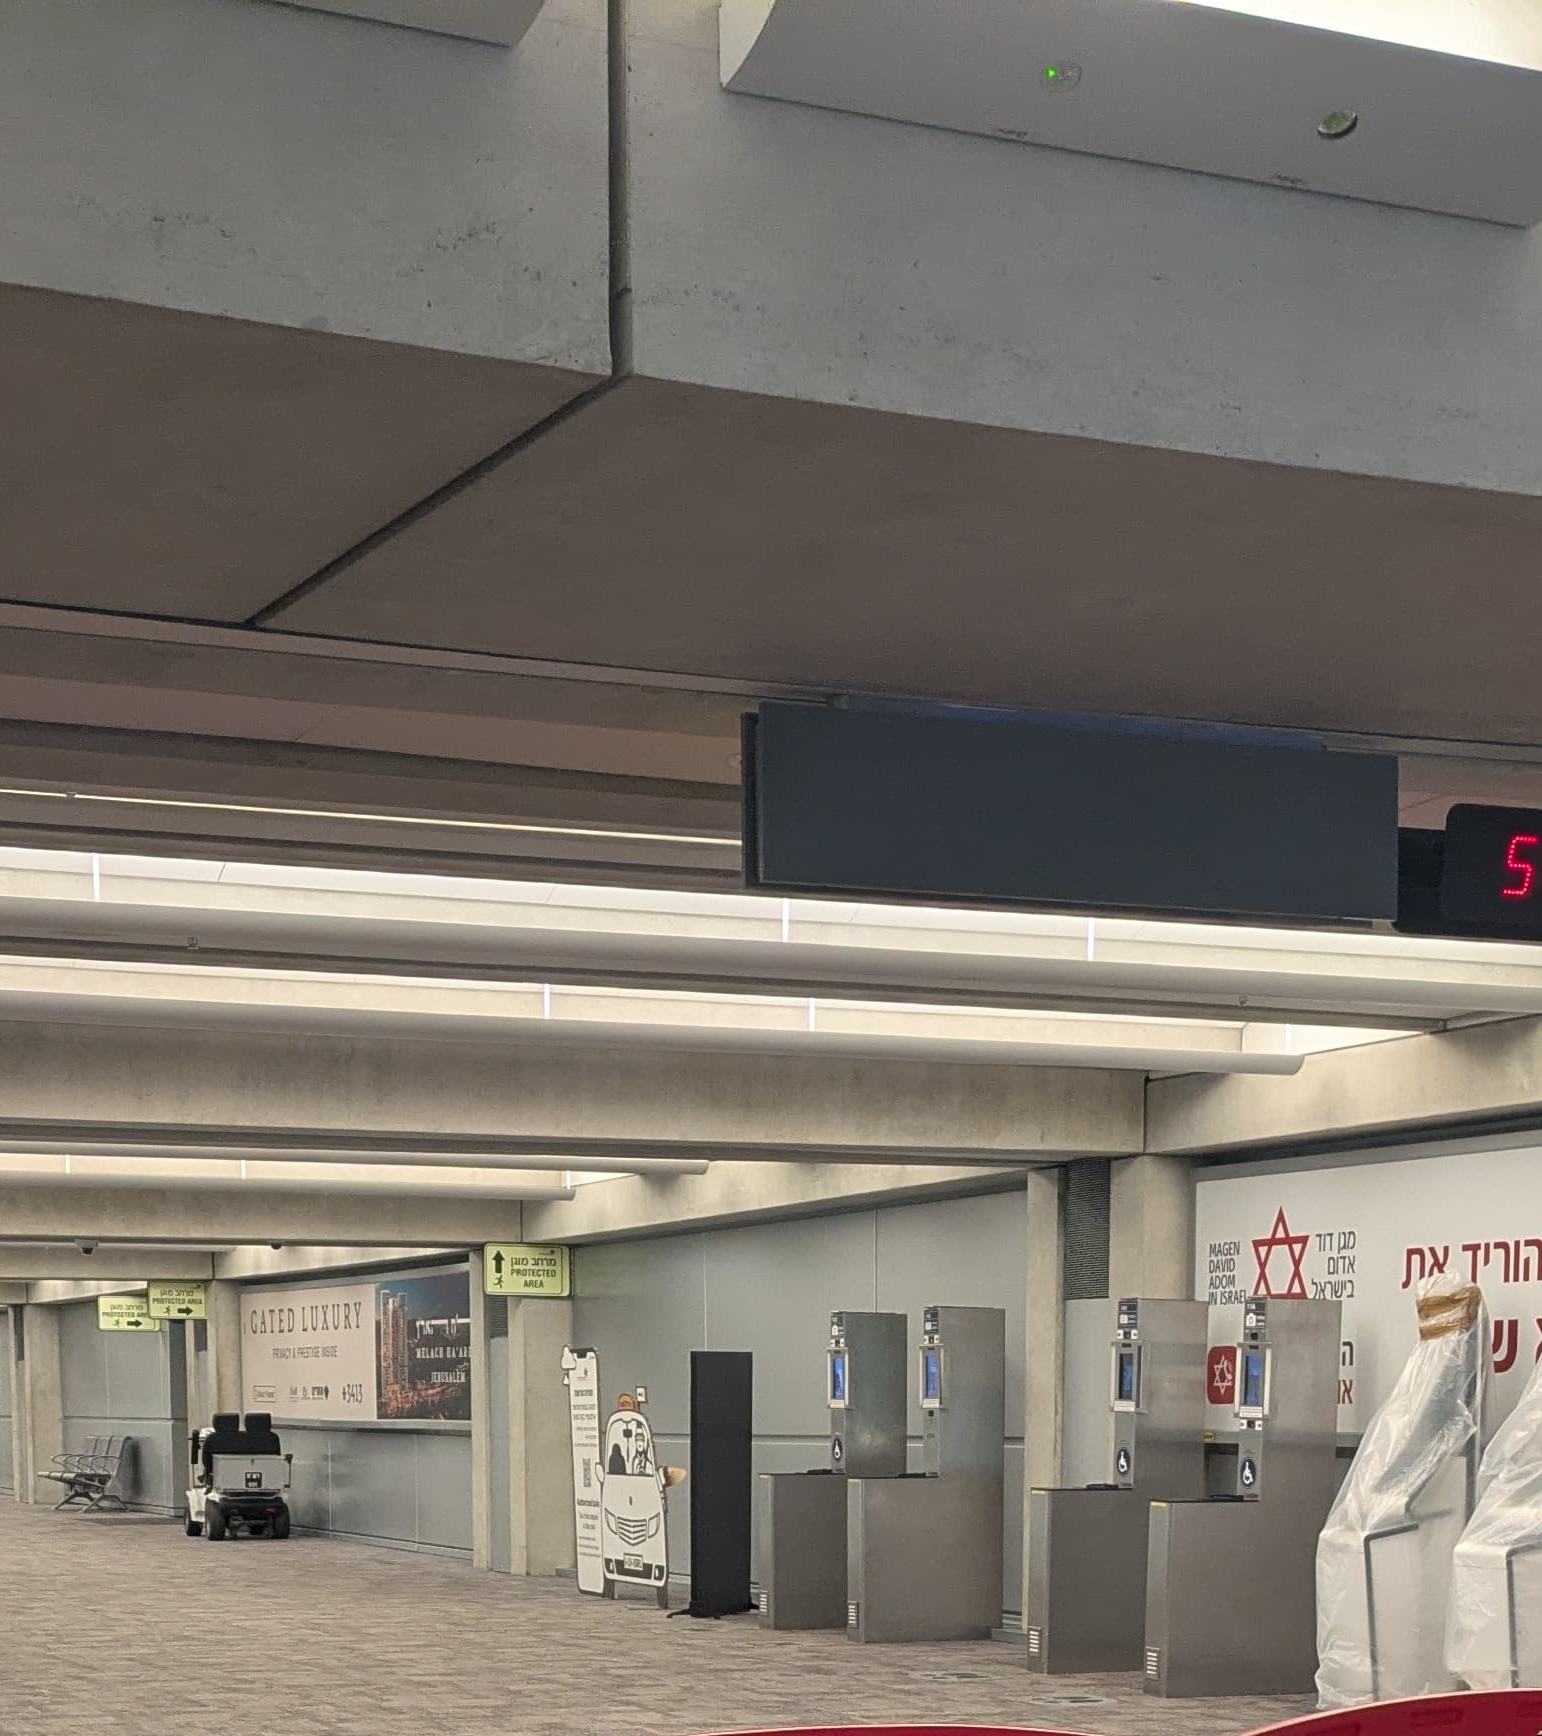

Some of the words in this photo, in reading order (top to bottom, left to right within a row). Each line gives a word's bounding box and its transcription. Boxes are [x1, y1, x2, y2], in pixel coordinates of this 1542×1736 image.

[1502, 834, 1538, 896] 5
[1209, 1241, 1241, 1257] MAGEN
[1315, 1232, 1334, 1253] דוד
[1337, 1231, 1356, 1254] מגן
[510, 1257, 528, 1267] מוגן
[531, 1257, 557, 1267] מרחב
[1209, 1258, 1235, 1273] DAVID
[1327, 1255, 1356, 1275] אדום
[1402, 1245, 1450, 1289] את
[510, 1268, 557, 1277] PROTECTED
[523, 1279, 544, 1288] AREA
[1209, 1274, 1236, 1289] ADOM
[1311, 1278, 1355, 1299] בישראל
[1209, 1291, 1218, 1305] IN
[250, 1307, 295, 1334] GATED
[301, 1302, 362, 1332] LUXURY
[431, 1371, 466, 1383] JERUSALEM
